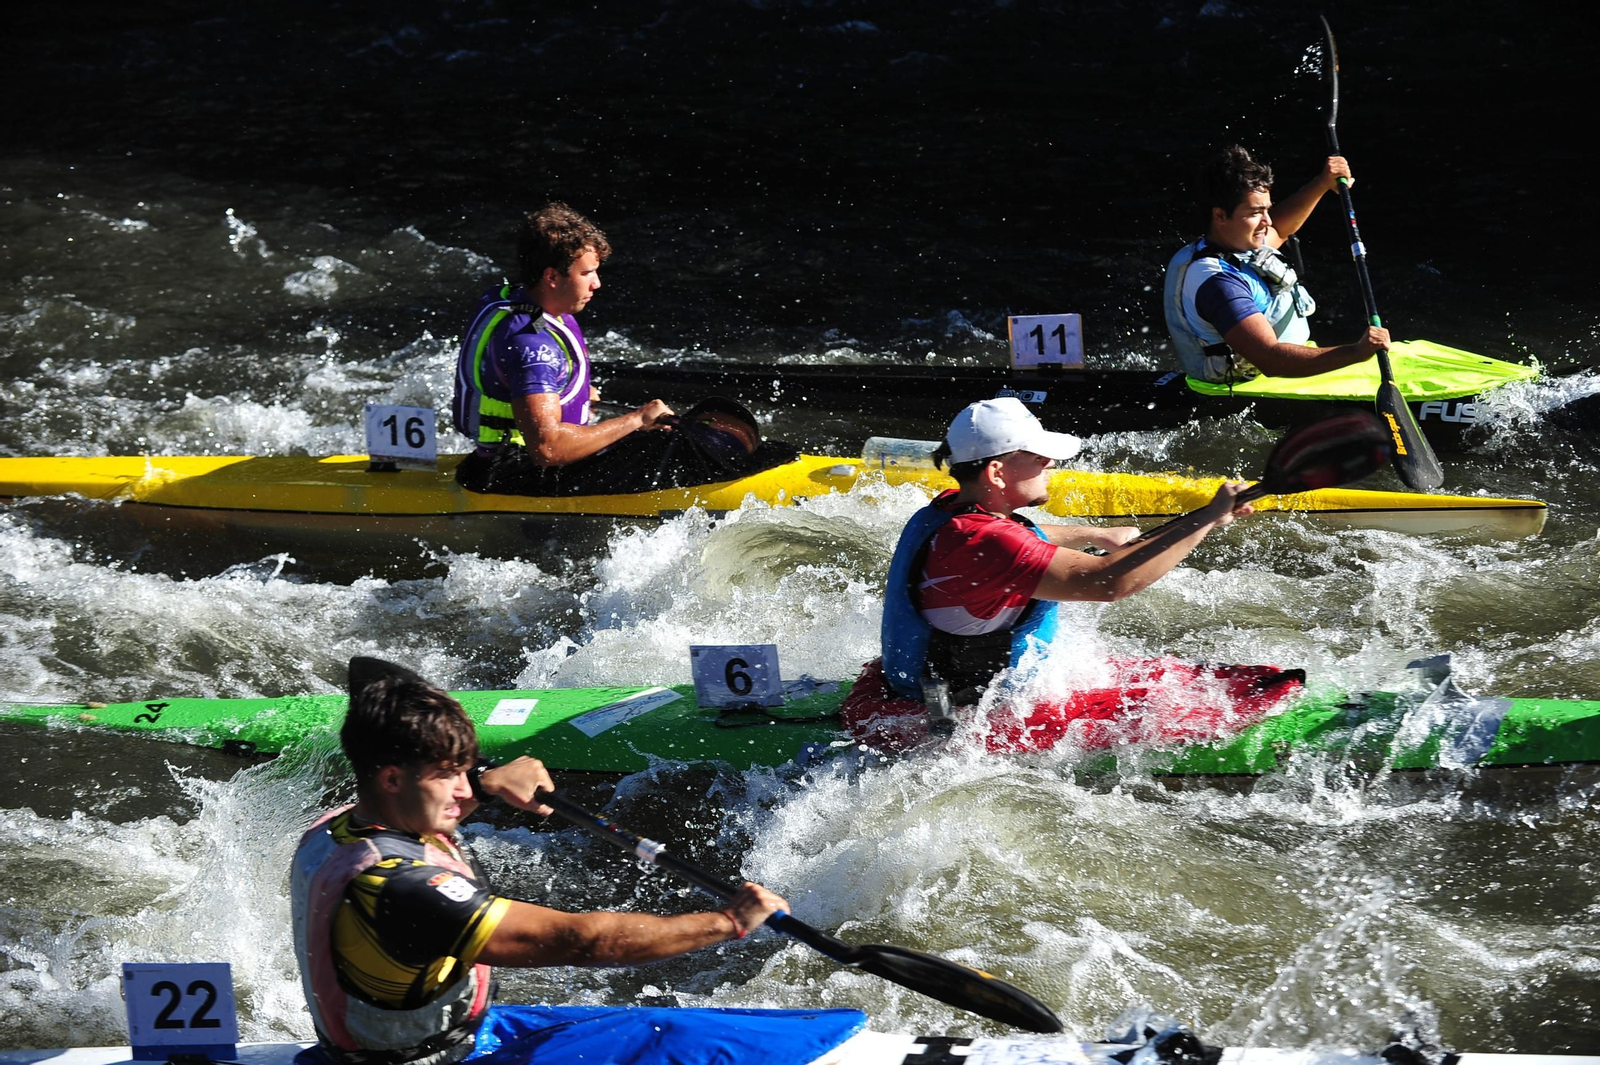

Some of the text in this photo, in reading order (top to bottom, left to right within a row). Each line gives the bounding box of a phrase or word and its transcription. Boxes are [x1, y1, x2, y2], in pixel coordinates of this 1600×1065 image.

[1030, 323, 1067, 355] 11
[383, 414, 426, 449] 16
[725, 657, 753, 696] 6
[134, 703, 170, 723] 24
[150, 979, 222, 1029] 22
